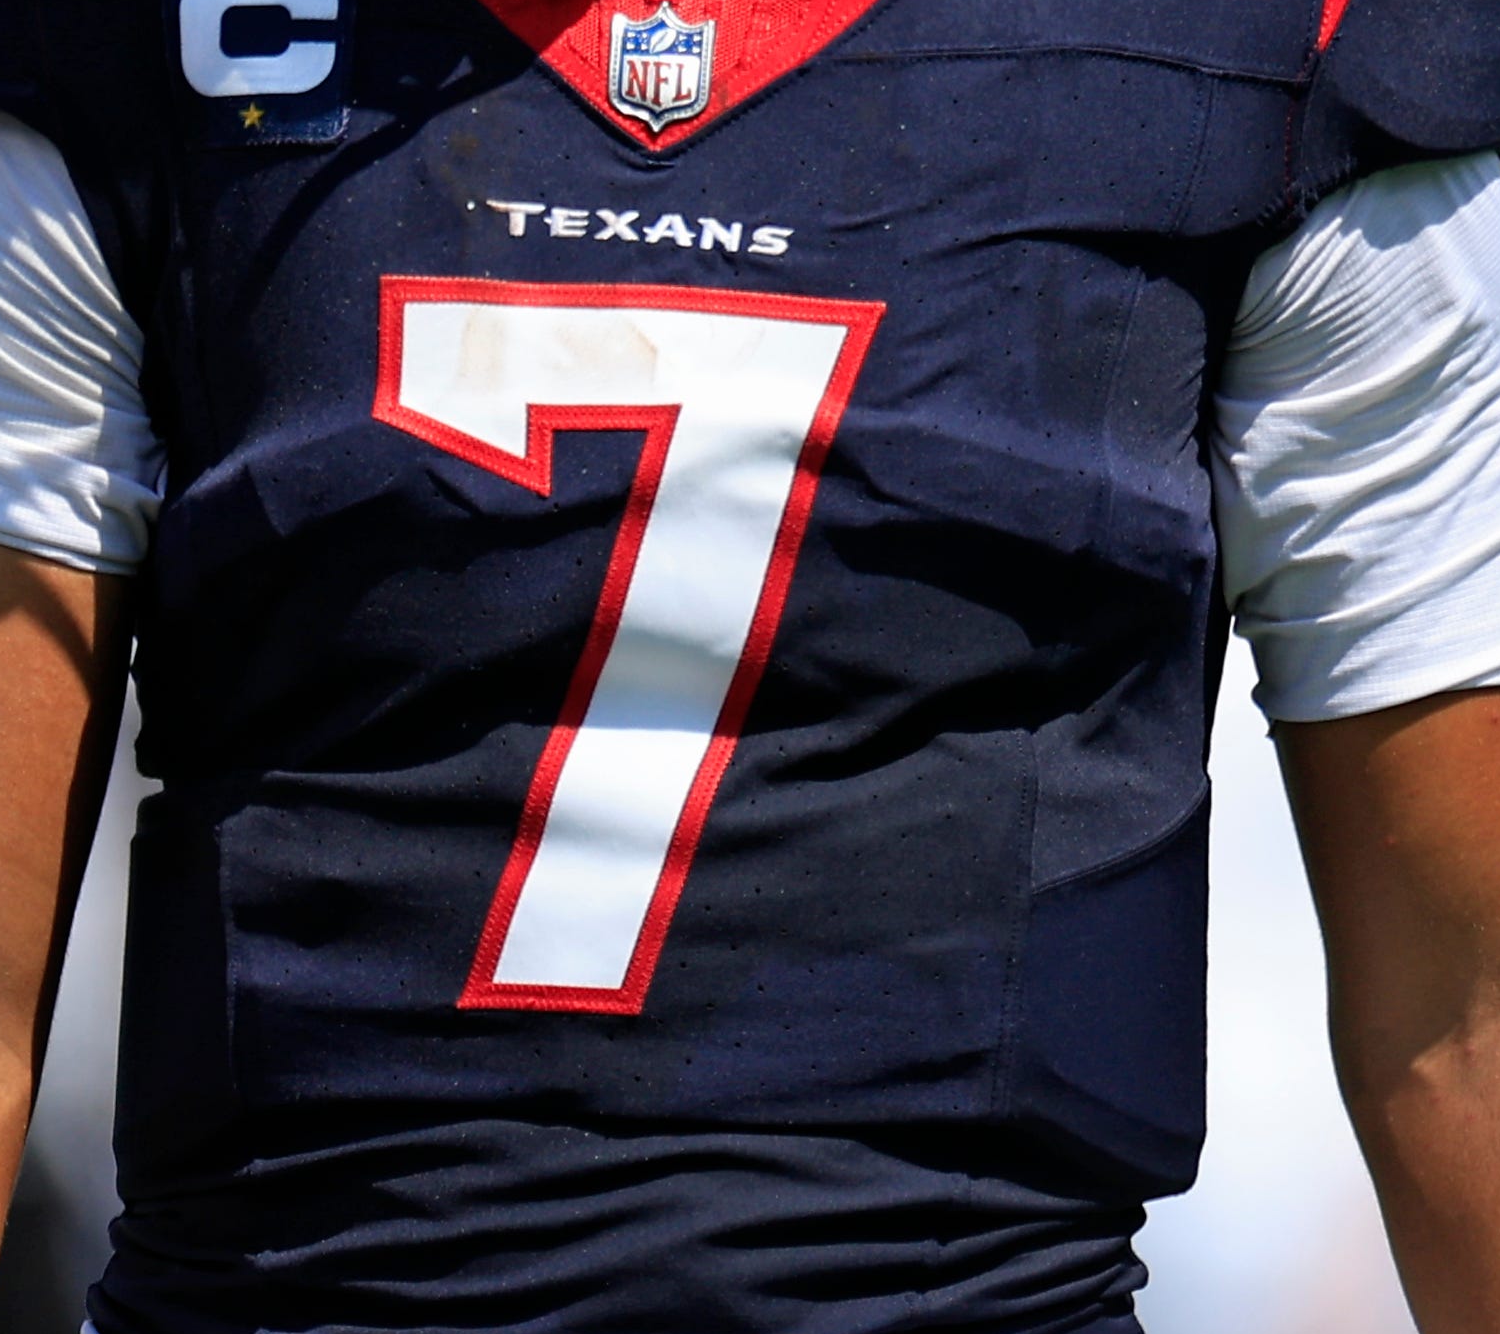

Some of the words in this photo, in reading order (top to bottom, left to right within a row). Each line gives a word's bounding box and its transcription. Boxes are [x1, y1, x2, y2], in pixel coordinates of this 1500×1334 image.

[625, 59, 692, 107] NFL
[486, 199, 794, 255] TEXANS
[372, 275, 886, 1014] 7
